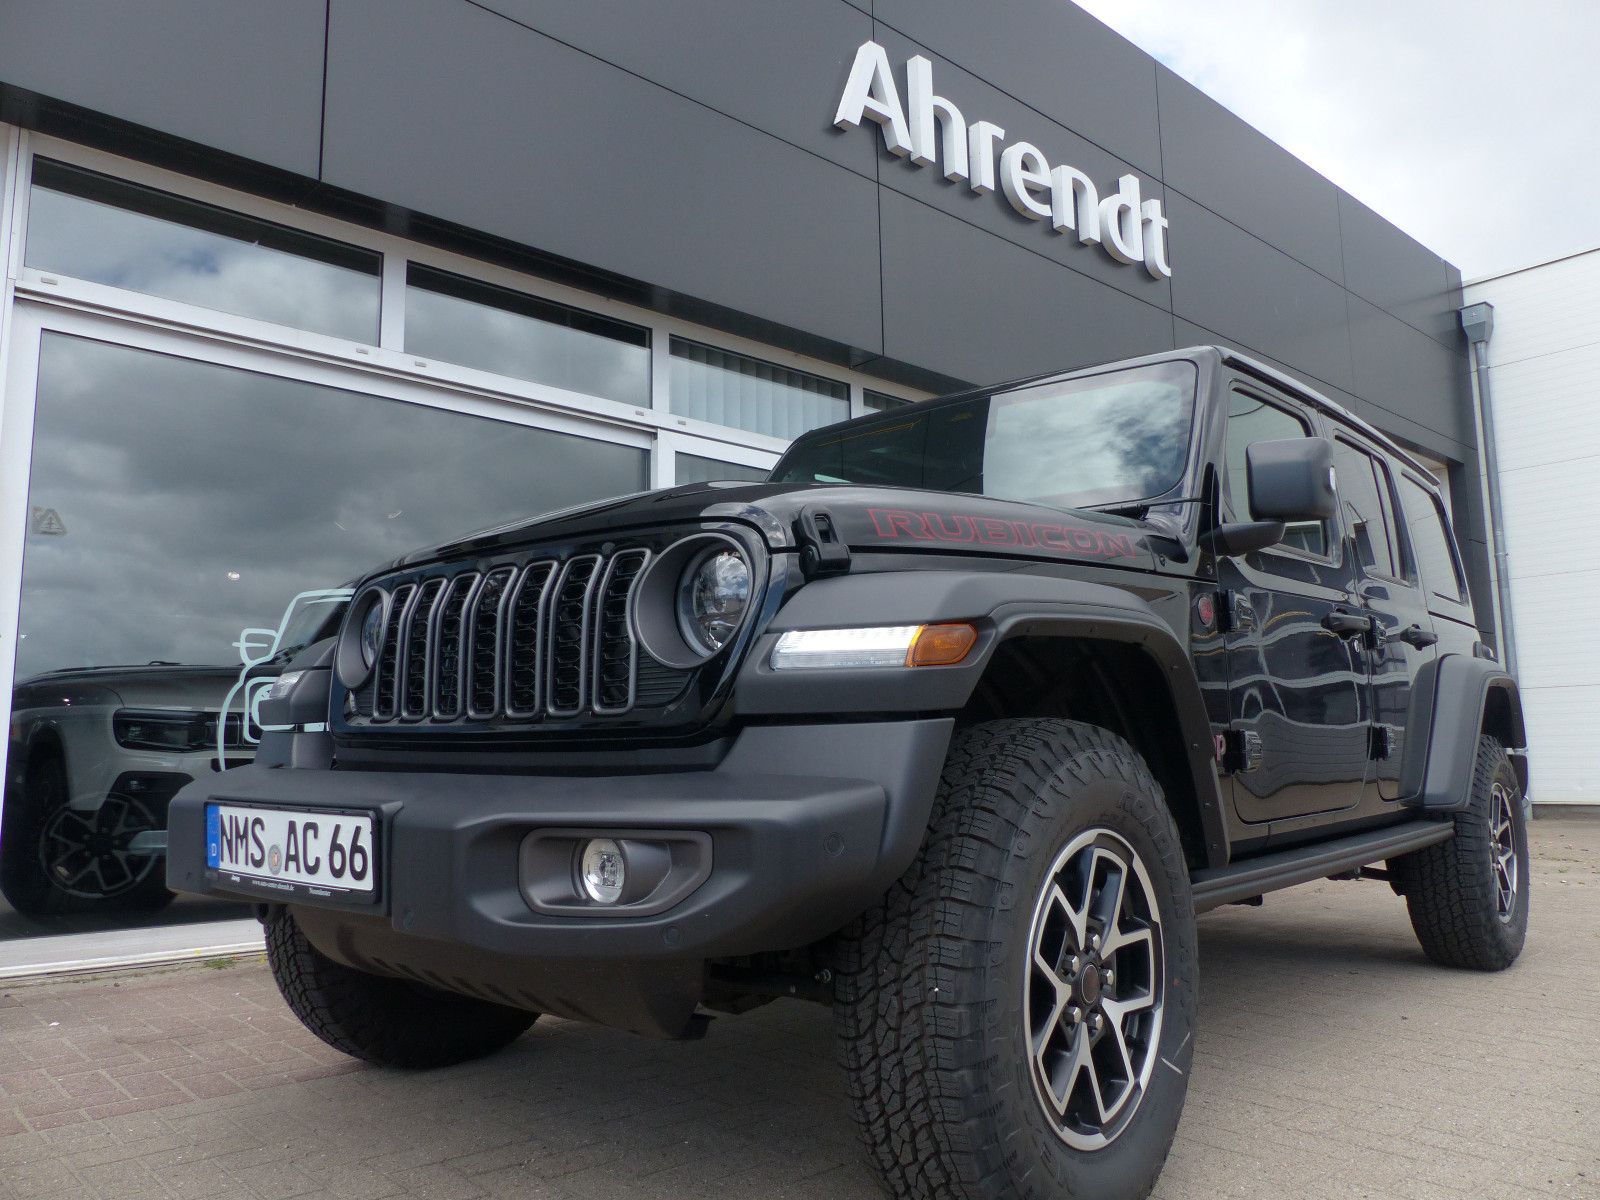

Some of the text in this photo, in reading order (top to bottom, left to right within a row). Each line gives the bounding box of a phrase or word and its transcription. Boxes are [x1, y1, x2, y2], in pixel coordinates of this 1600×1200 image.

[833, 40, 1172, 279] Ahrendt
[867, 508, 1137, 560] RUBICON
[220, 814, 368, 881] NMS AC 66
